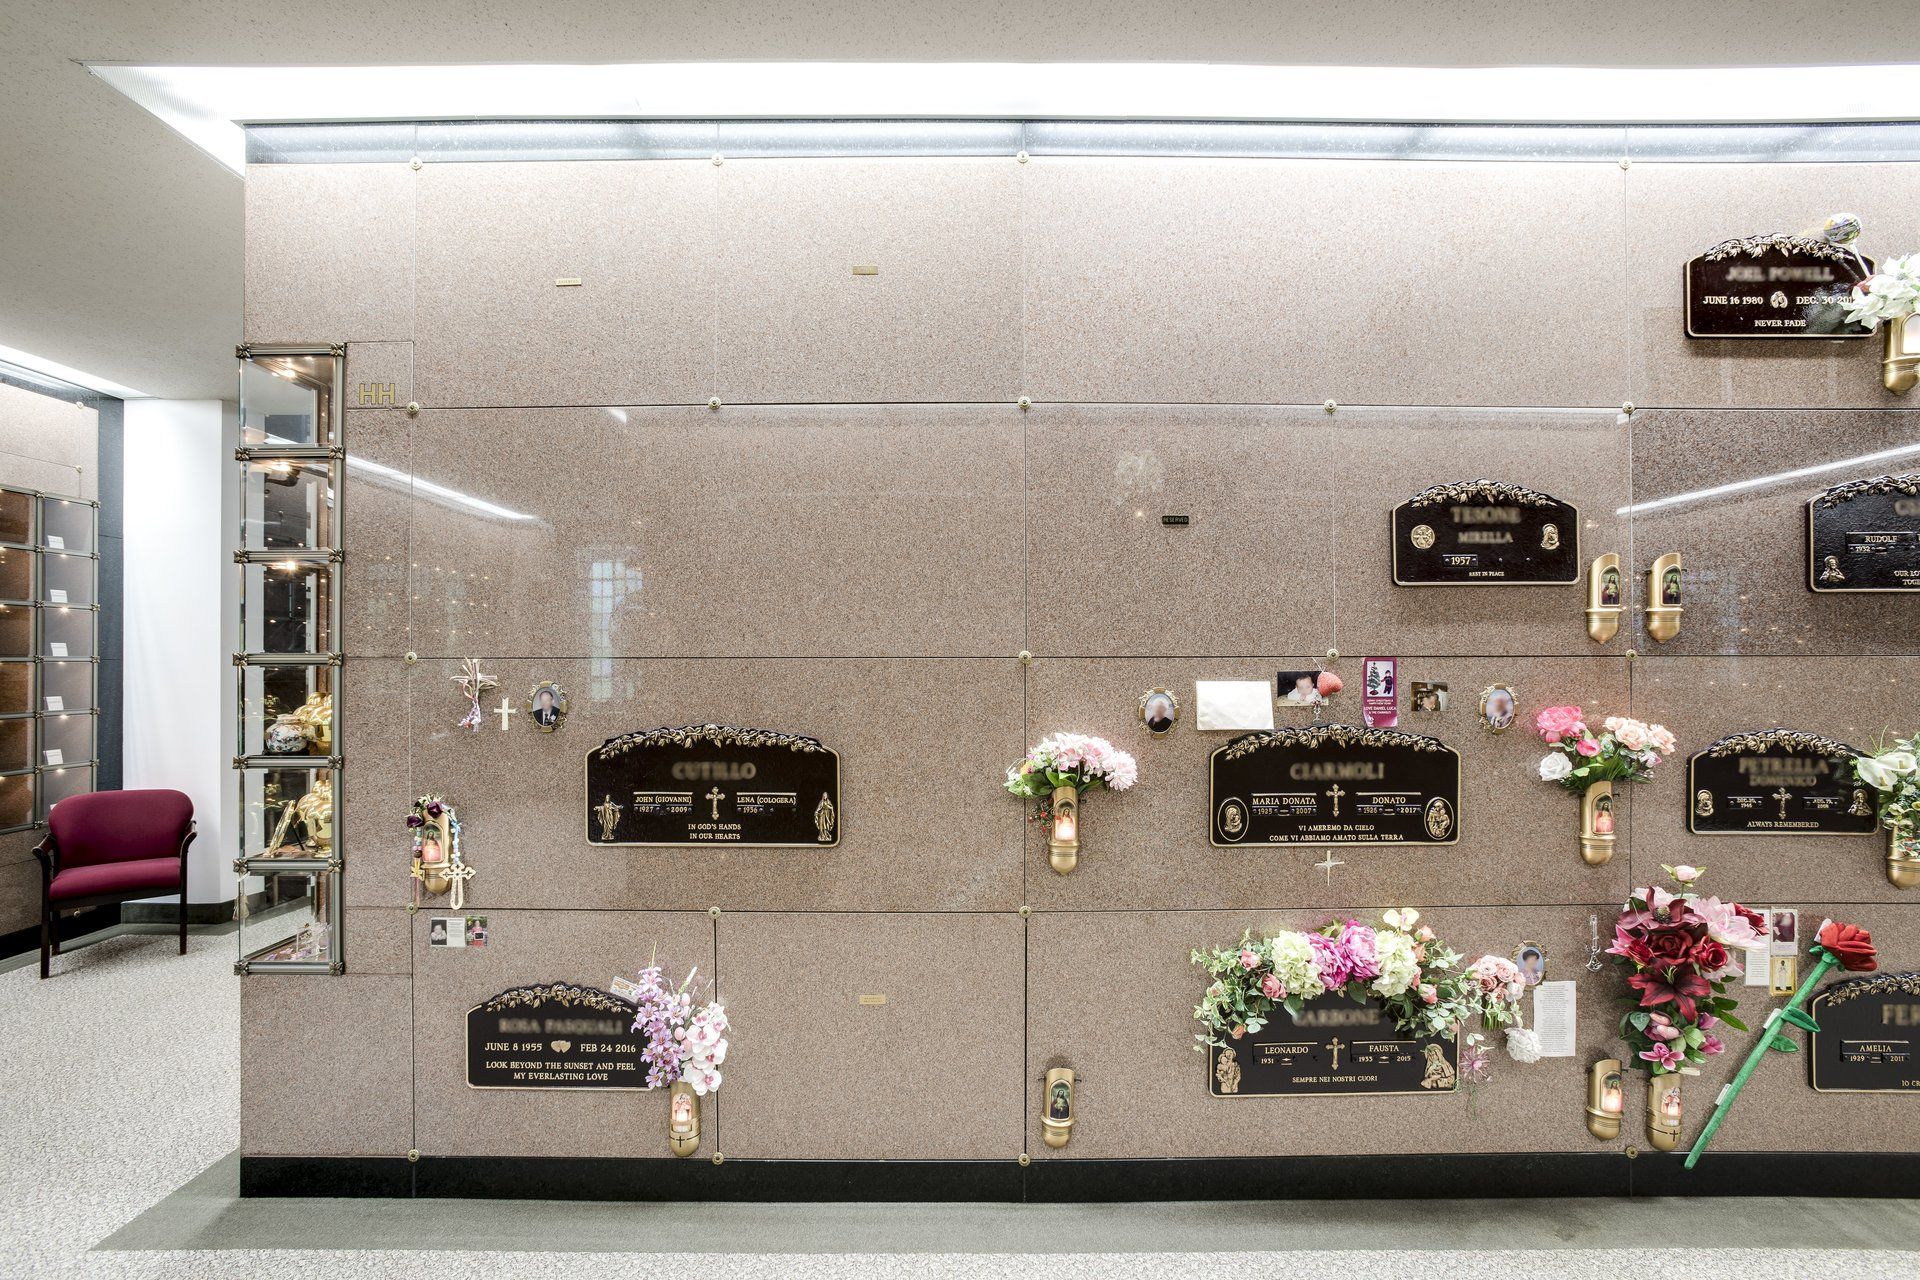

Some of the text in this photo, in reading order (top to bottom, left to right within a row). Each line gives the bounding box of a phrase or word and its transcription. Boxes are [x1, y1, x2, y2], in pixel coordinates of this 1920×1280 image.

[1702, 296, 1764, 305] JUNE 16 1980
[1796, 296, 1856, 305] DEC. 30 201
[1754, 319, 1806, 327] NEVER FADE
[359, 383, 395, 405] HH
[1865, 535, 1897, 543] RUDOLF
[1450, 556, 1471, 566] 1957
[655, 795, 692, 805] (GIOVANNI)
[757, 795, 796, 805] (COLOGERA)
[1252, 797, 1317, 805] MARIA DONATA
[1372, 796, 1407, 804] DONATO
[485, 1042, 543, 1052] JUNE 8 1955
[580, 1043, 636, 1053] FEB 24 2016
[1265, 1046, 1309, 1054] LEONARDO
[486, 1061, 508, 1069] LOOK
[510, 1061, 542, 1069] BEYOND
[563, 1062, 593, 1070] SUNSET
[513, 1072, 609, 1081] MY EVERLASTING LOVE
